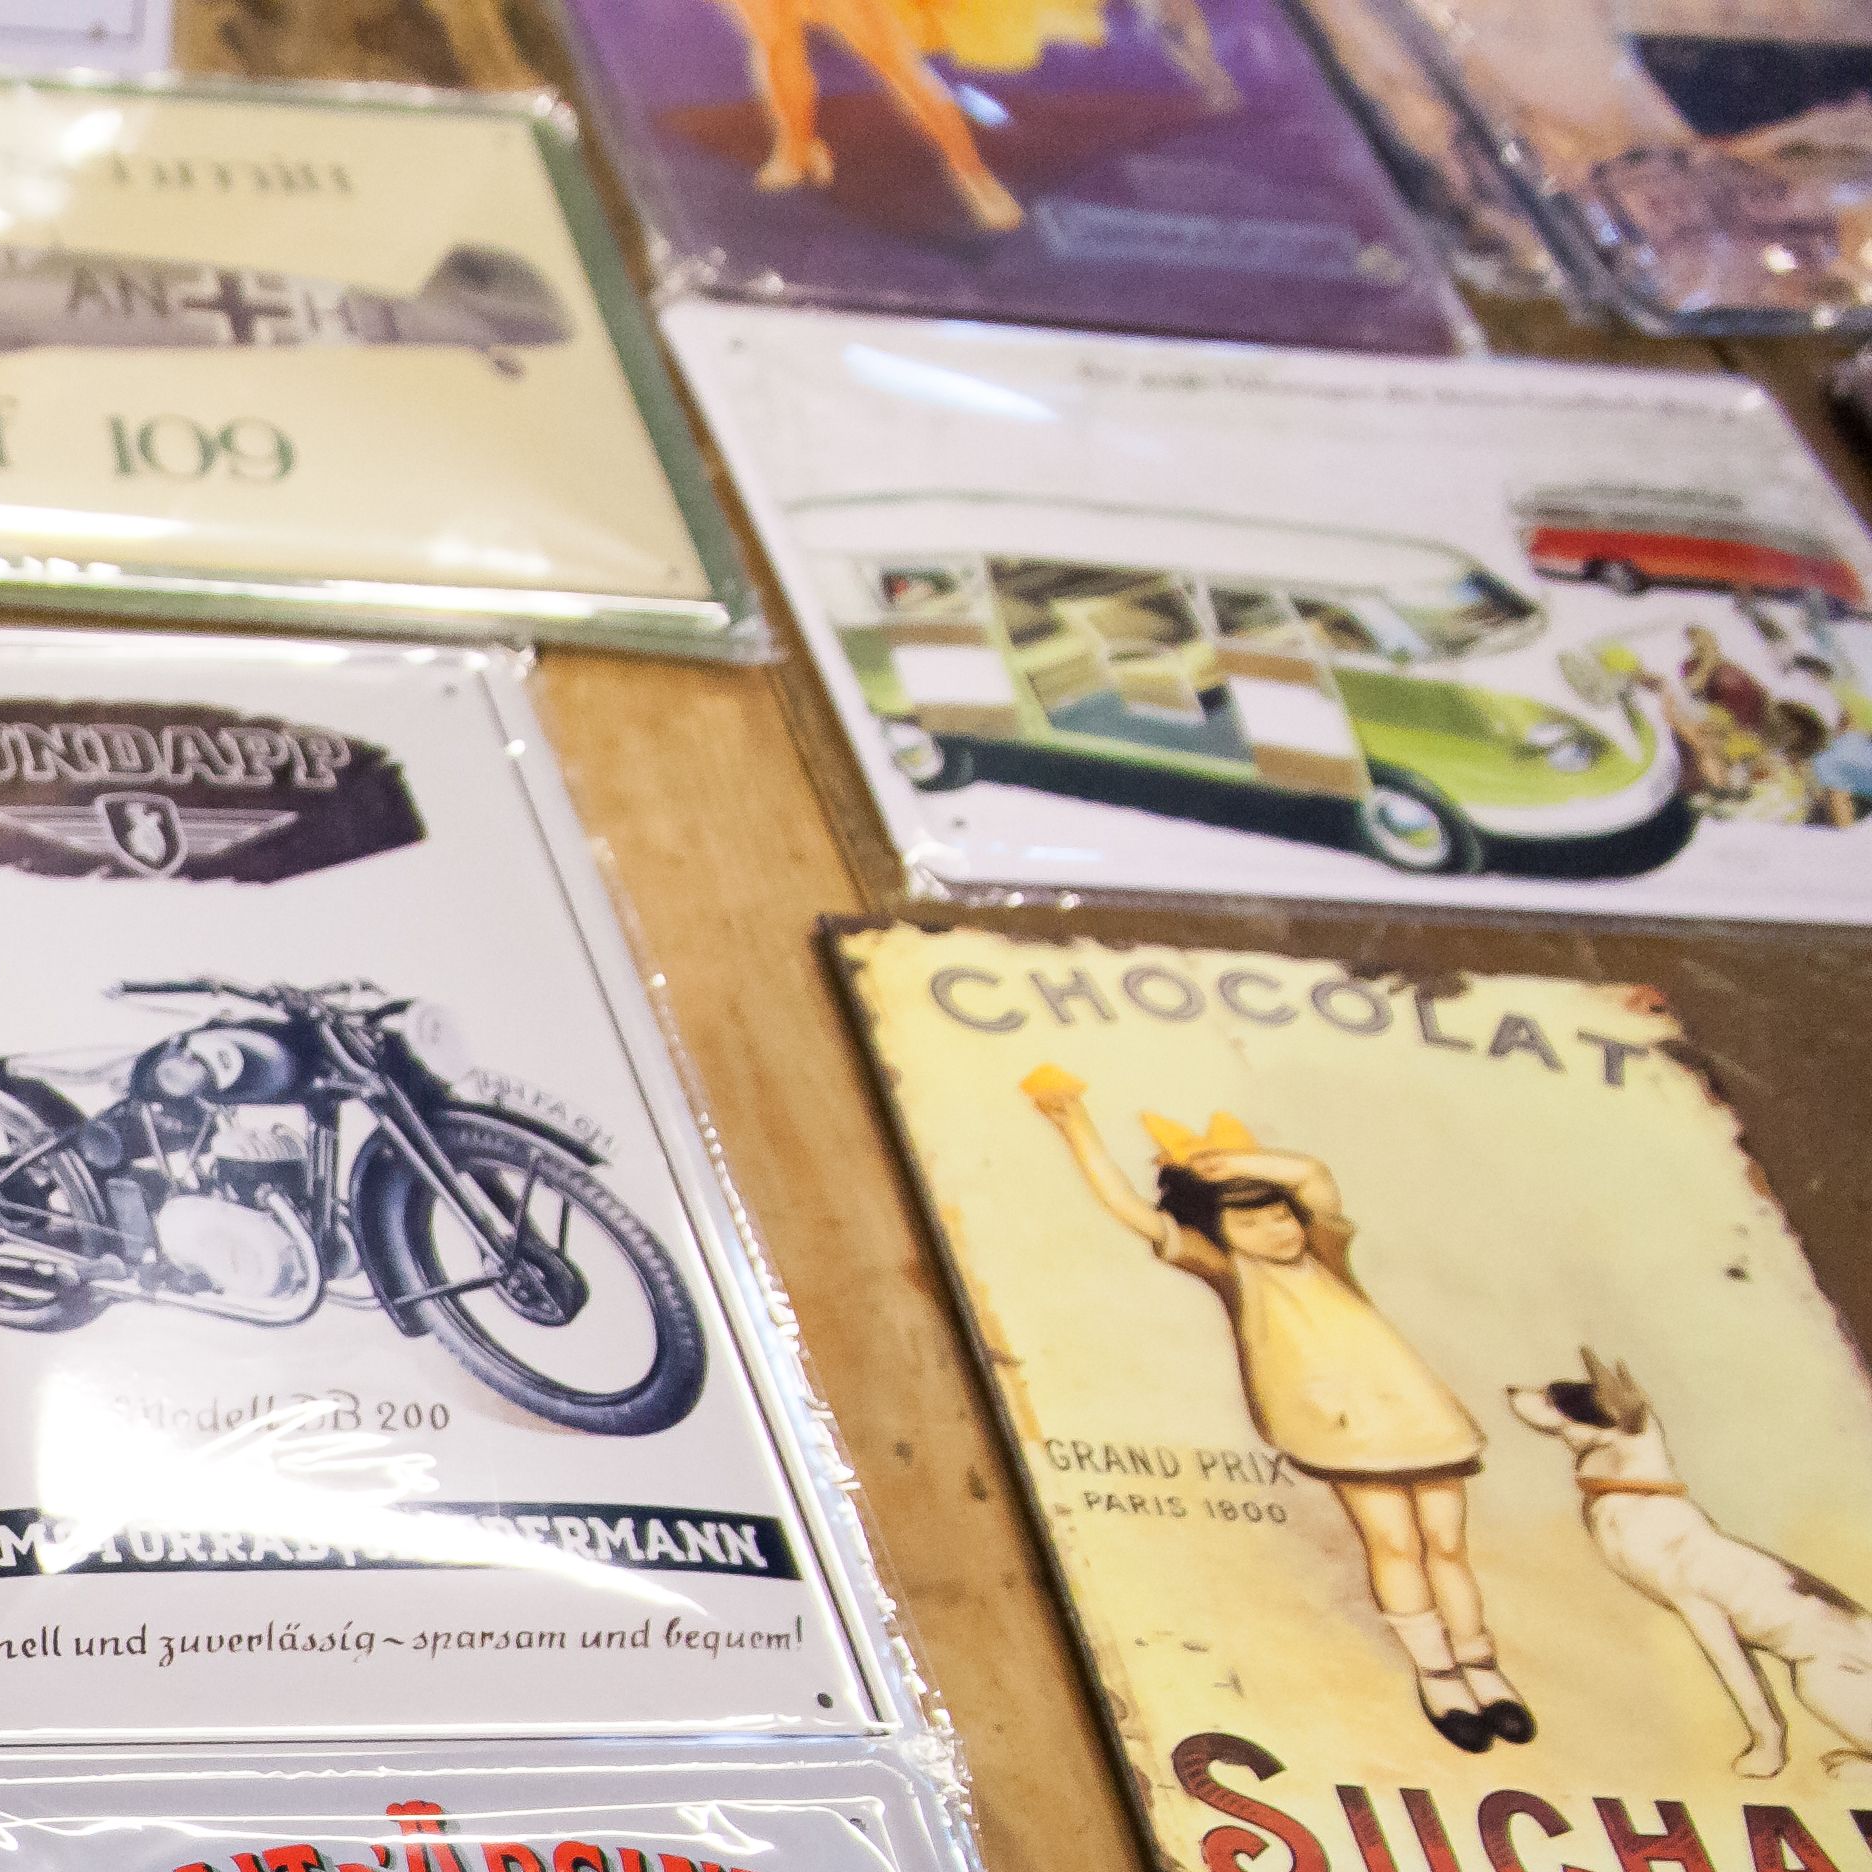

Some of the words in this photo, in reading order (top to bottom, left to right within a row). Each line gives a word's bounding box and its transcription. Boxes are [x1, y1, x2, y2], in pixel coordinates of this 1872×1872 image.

[106, 413, 299, 484] 109
[928, 965, 1652, 1087] CHOCOLAT
[375, 1400, 451, 1432] 200
[1046, 1438, 1182, 1480] GRAND
[1196, 1447, 1296, 1488] PRIX
[1082, 1489, 1189, 1519] PARIS
[74, 1622, 148, 1657] und
[581, 1618, 653, 1651] und
